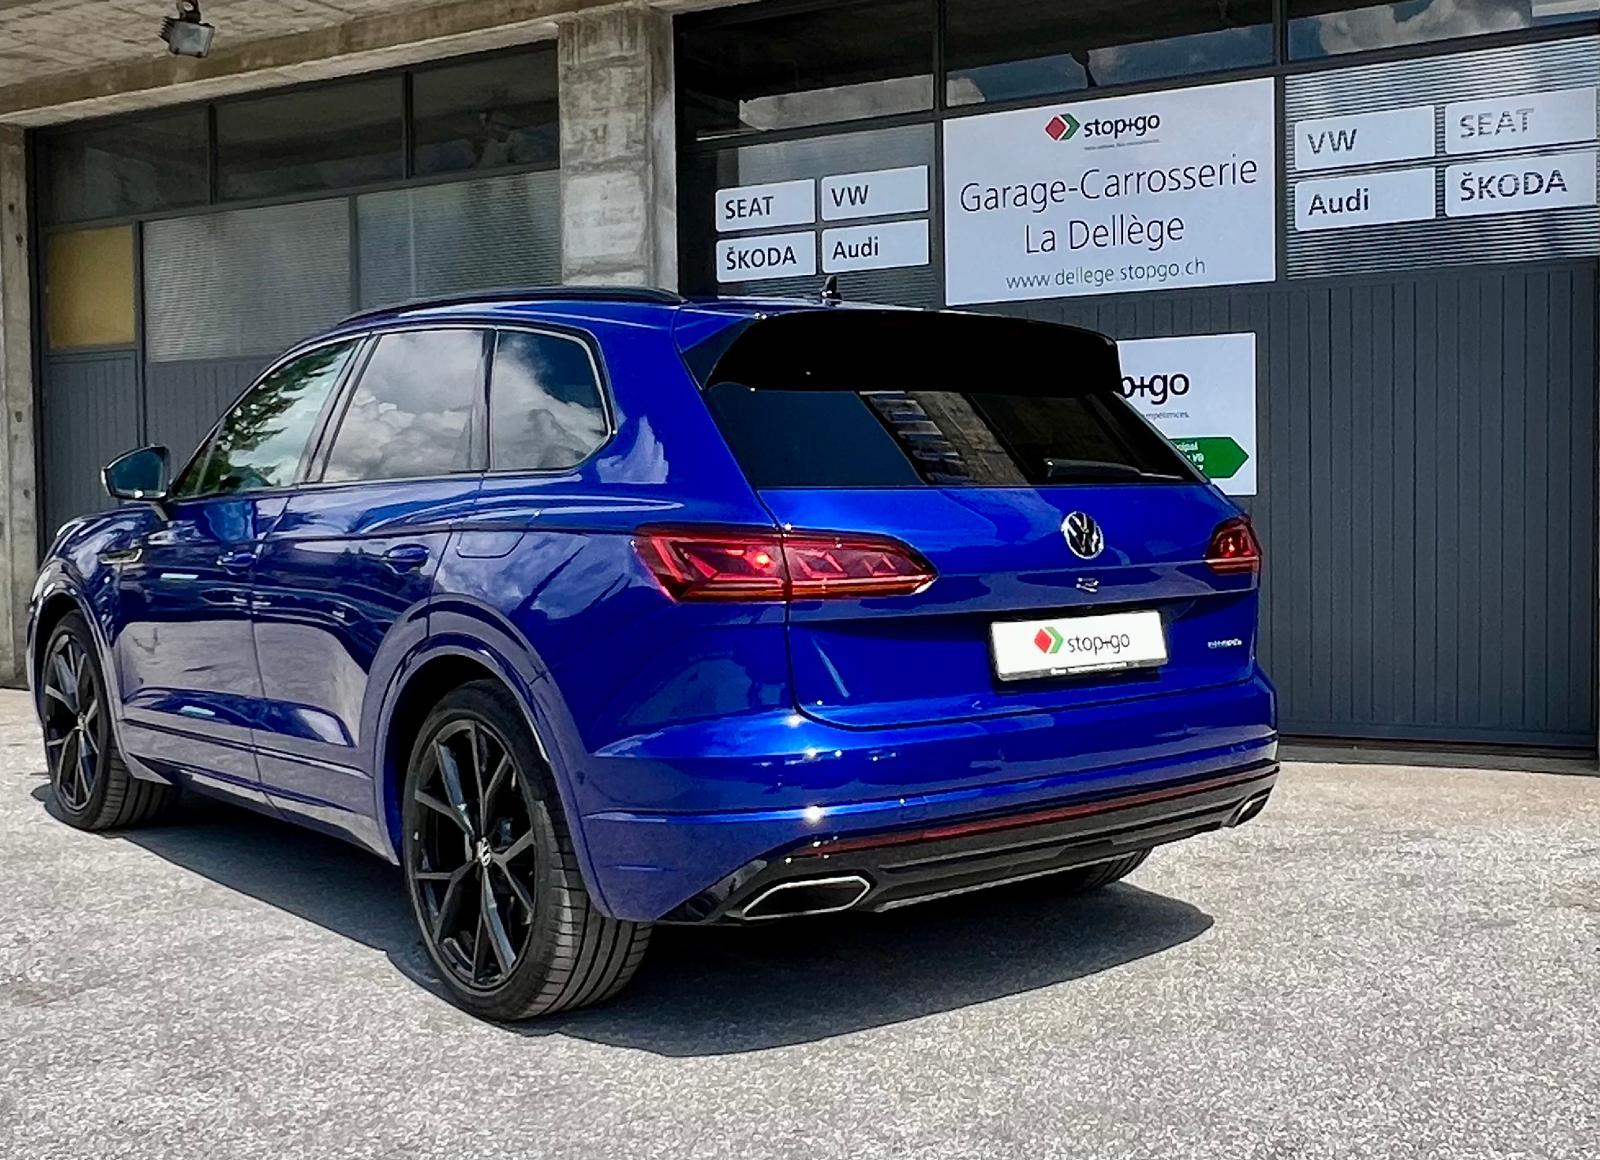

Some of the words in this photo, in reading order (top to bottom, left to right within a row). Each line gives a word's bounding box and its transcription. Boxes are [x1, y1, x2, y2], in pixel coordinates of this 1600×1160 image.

[1083, 113, 1161, 139] stop+go
[1459, 107, 1535, 139] SEAT
[1306, 128, 1358, 155] VW
[831, 184, 869, 207] VW
[959, 153, 1258, 213] Garage-Carrosserie
[1459, 168, 1568, 202] ŠKODA
[724, 195, 774, 220] SEAT
[1307, 187, 1370, 216] Audi
[1025, 224, 1056, 254] La
[1069, 214, 1185, 251] Dellège
[726, 245, 797, 271] ŠKODA
[832, 236, 879, 261] Audi
[1006, 256, 1206, 289] www.dellege.stopgo.ch
[1121, 373, 1190, 405] p+go
[1067, 632, 1130, 656] stop+go
